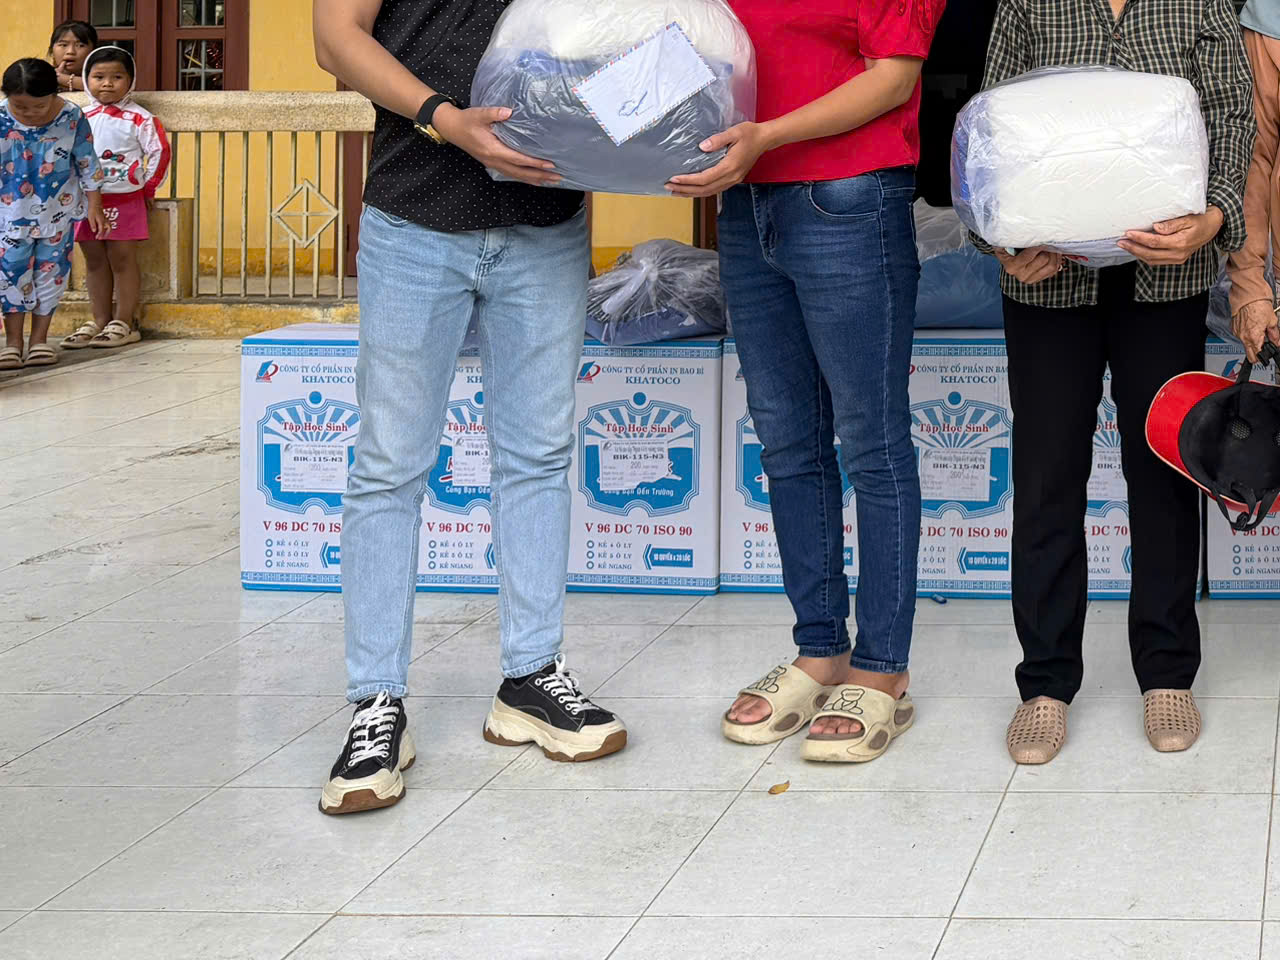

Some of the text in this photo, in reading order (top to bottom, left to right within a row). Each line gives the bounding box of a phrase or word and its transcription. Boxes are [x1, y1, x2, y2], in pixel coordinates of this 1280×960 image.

[280, 364, 299, 372] CÔNG
[602, 364, 622, 374] CÔNG
[916, 364, 938, 373] CÔNG
[302, 375, 355, 384] KHATOCO
[626, 376, 681, 385] KHATOCO
[940, 375, 997, 384] KHATOCO
[282, 421, 348, 433] Tập Học Sinh
[448, 422, 466, 432] Tập
[605, 424, 674, 434] Tập Học Sinh
[920, 424, 989, 434] Tập Học Sinh
[263, 520, 341, 533] V 96 DC 70 IS
[426, 522, 491, 533] V 96 DC 70
[585, 522, 693, 536] V 96 DC 70 ISO 90
[742, 522, 768, 532] V 96
[1091, 525, 1128, 536] DC 70
[1261, 526, 1280, 536] DC
[928, 526, 946, 536] DC
[950, 527, 964, 537] 70
[968, 527, 990, 538] ISO
[994, 528, 1008, 538] 90
